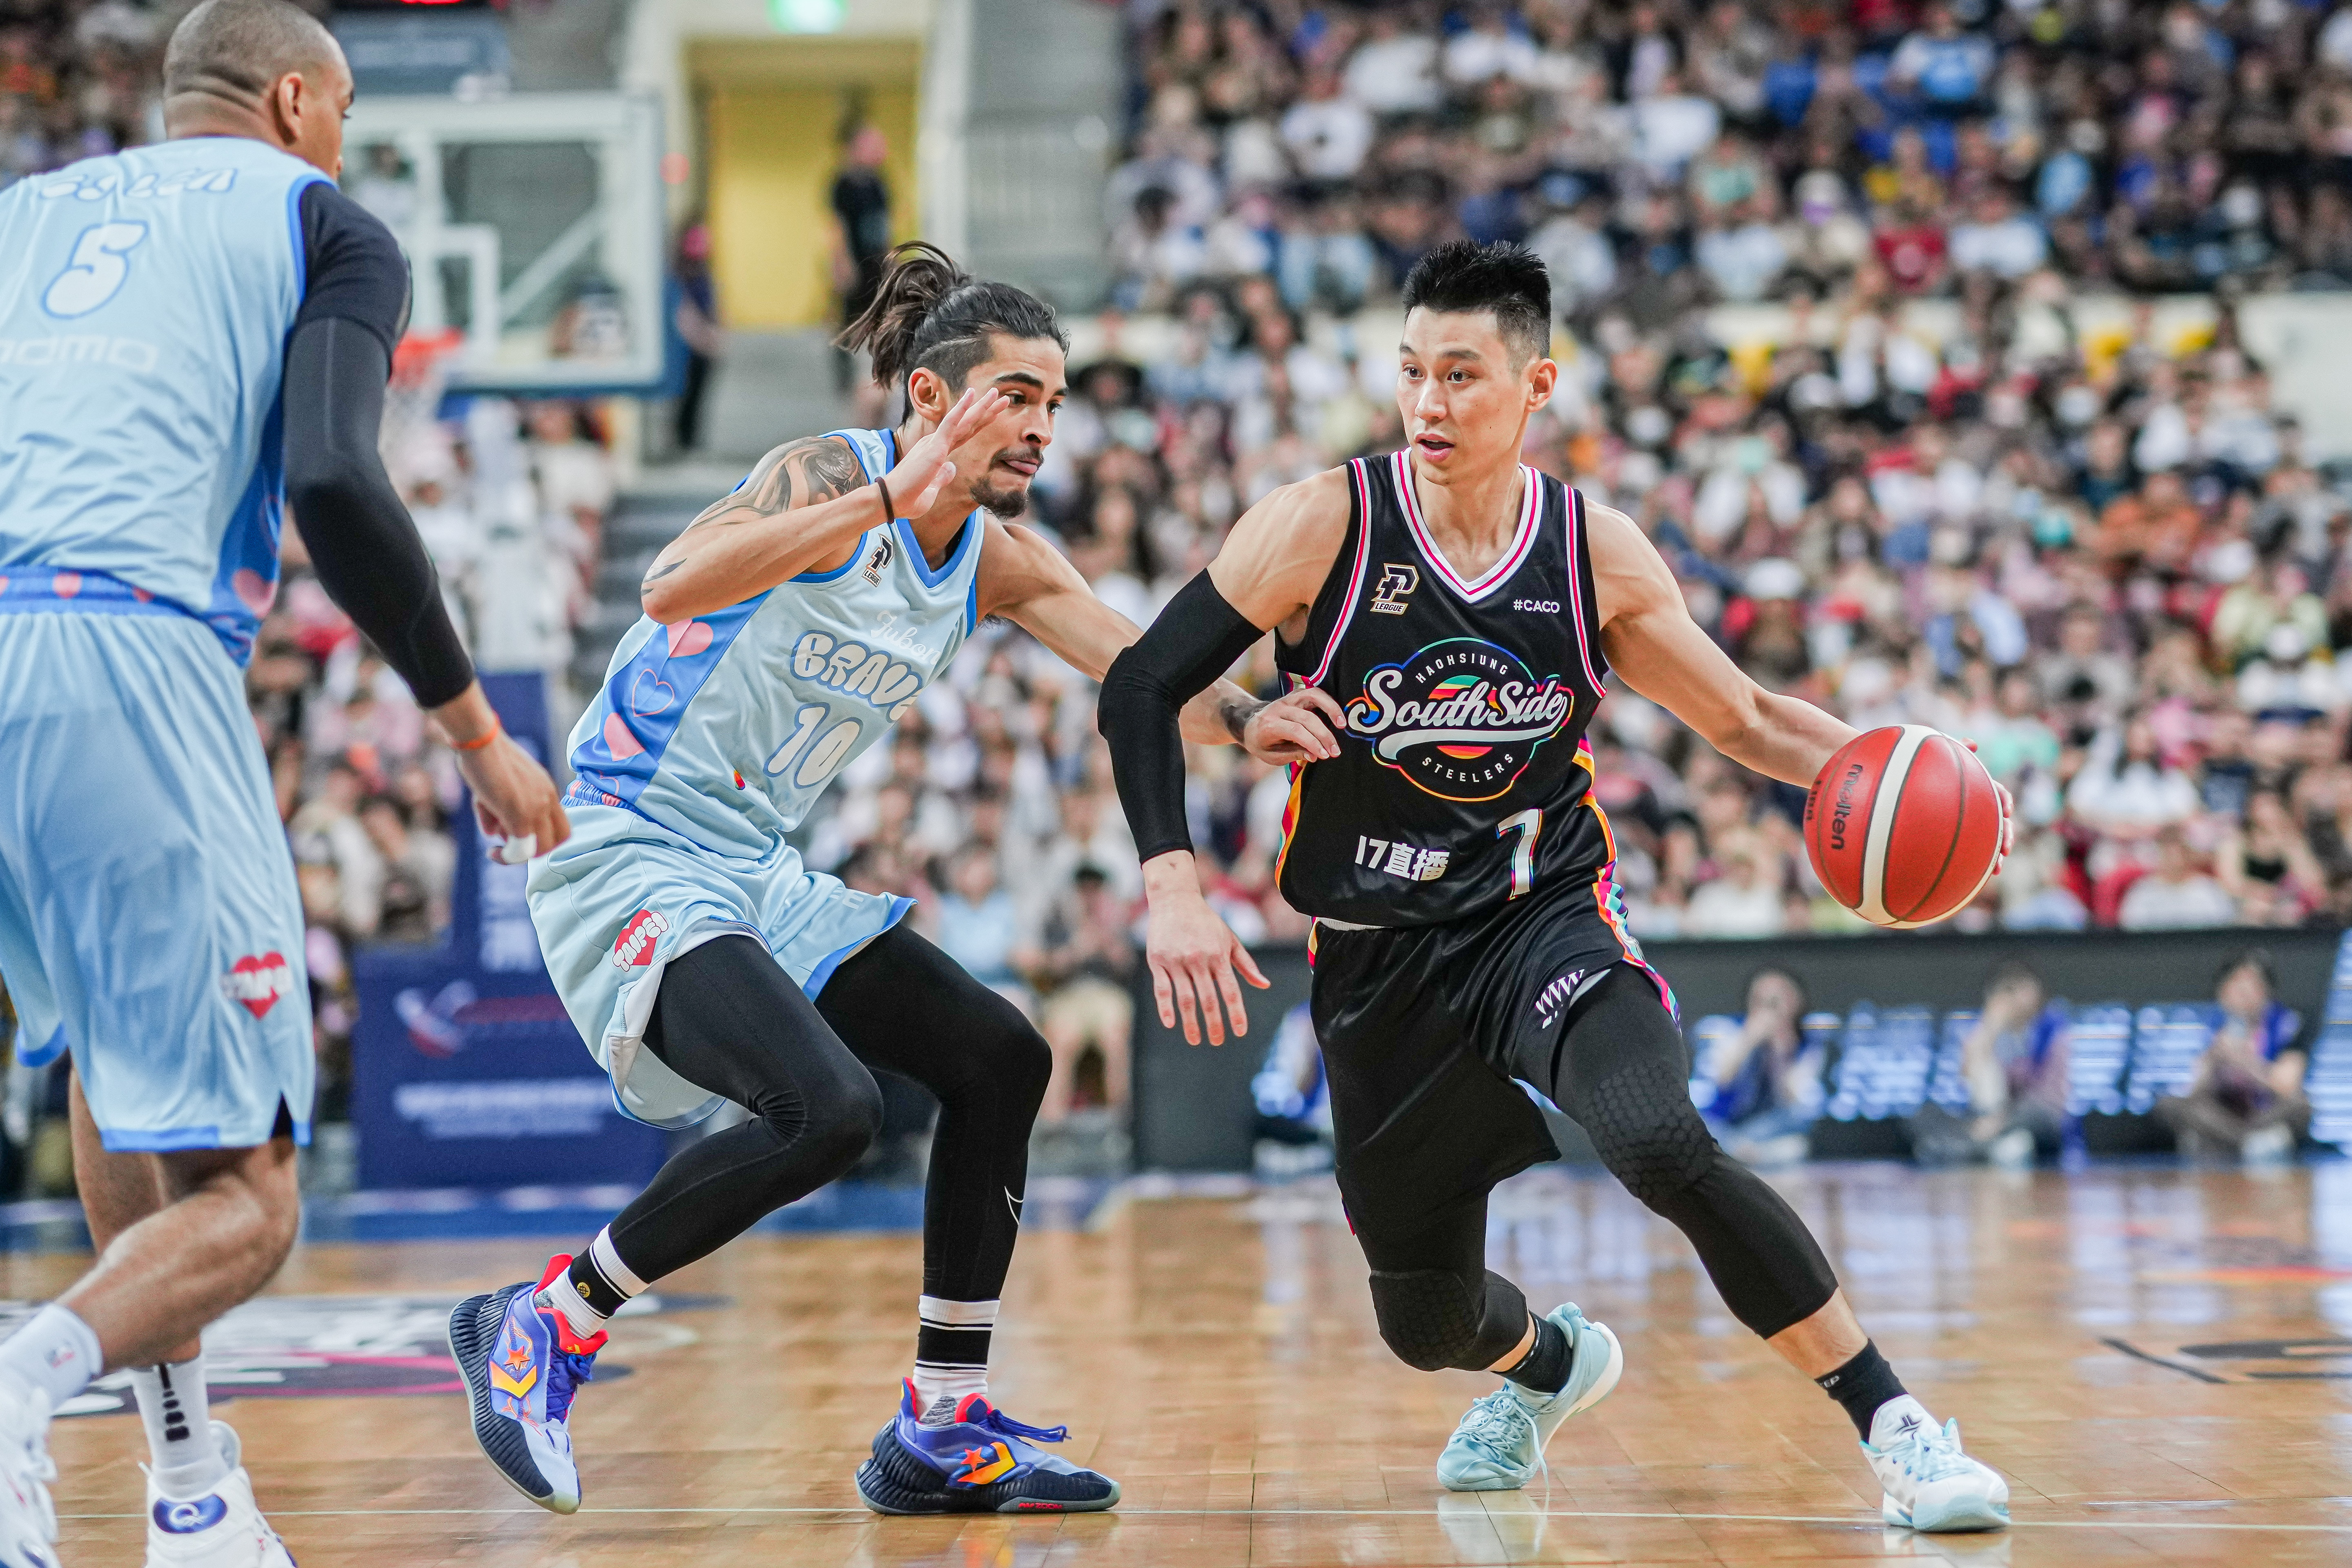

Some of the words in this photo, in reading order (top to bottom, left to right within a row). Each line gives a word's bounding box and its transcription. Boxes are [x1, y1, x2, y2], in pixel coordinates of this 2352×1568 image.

[40, 219, 150, 321] 5
[864, 570, 880, 585] LEAGUE
[1374, 603, 1404, 612] LEAGUE
[1513, 599, 1560, 613] #CACO
[1348, 670, 1492, 733] South
[1487, 680, 1568, 726] Side
[763, 702, 864, 789] 10
[1421, 753, 1513, 783] STEELERS
[1831, 764, 1863, 850] molten
[1355, 835, 1450, 881] 17直播
[1495, 808, 1543, 901] 7
[612, 911, 668, 972] TAIPEI
